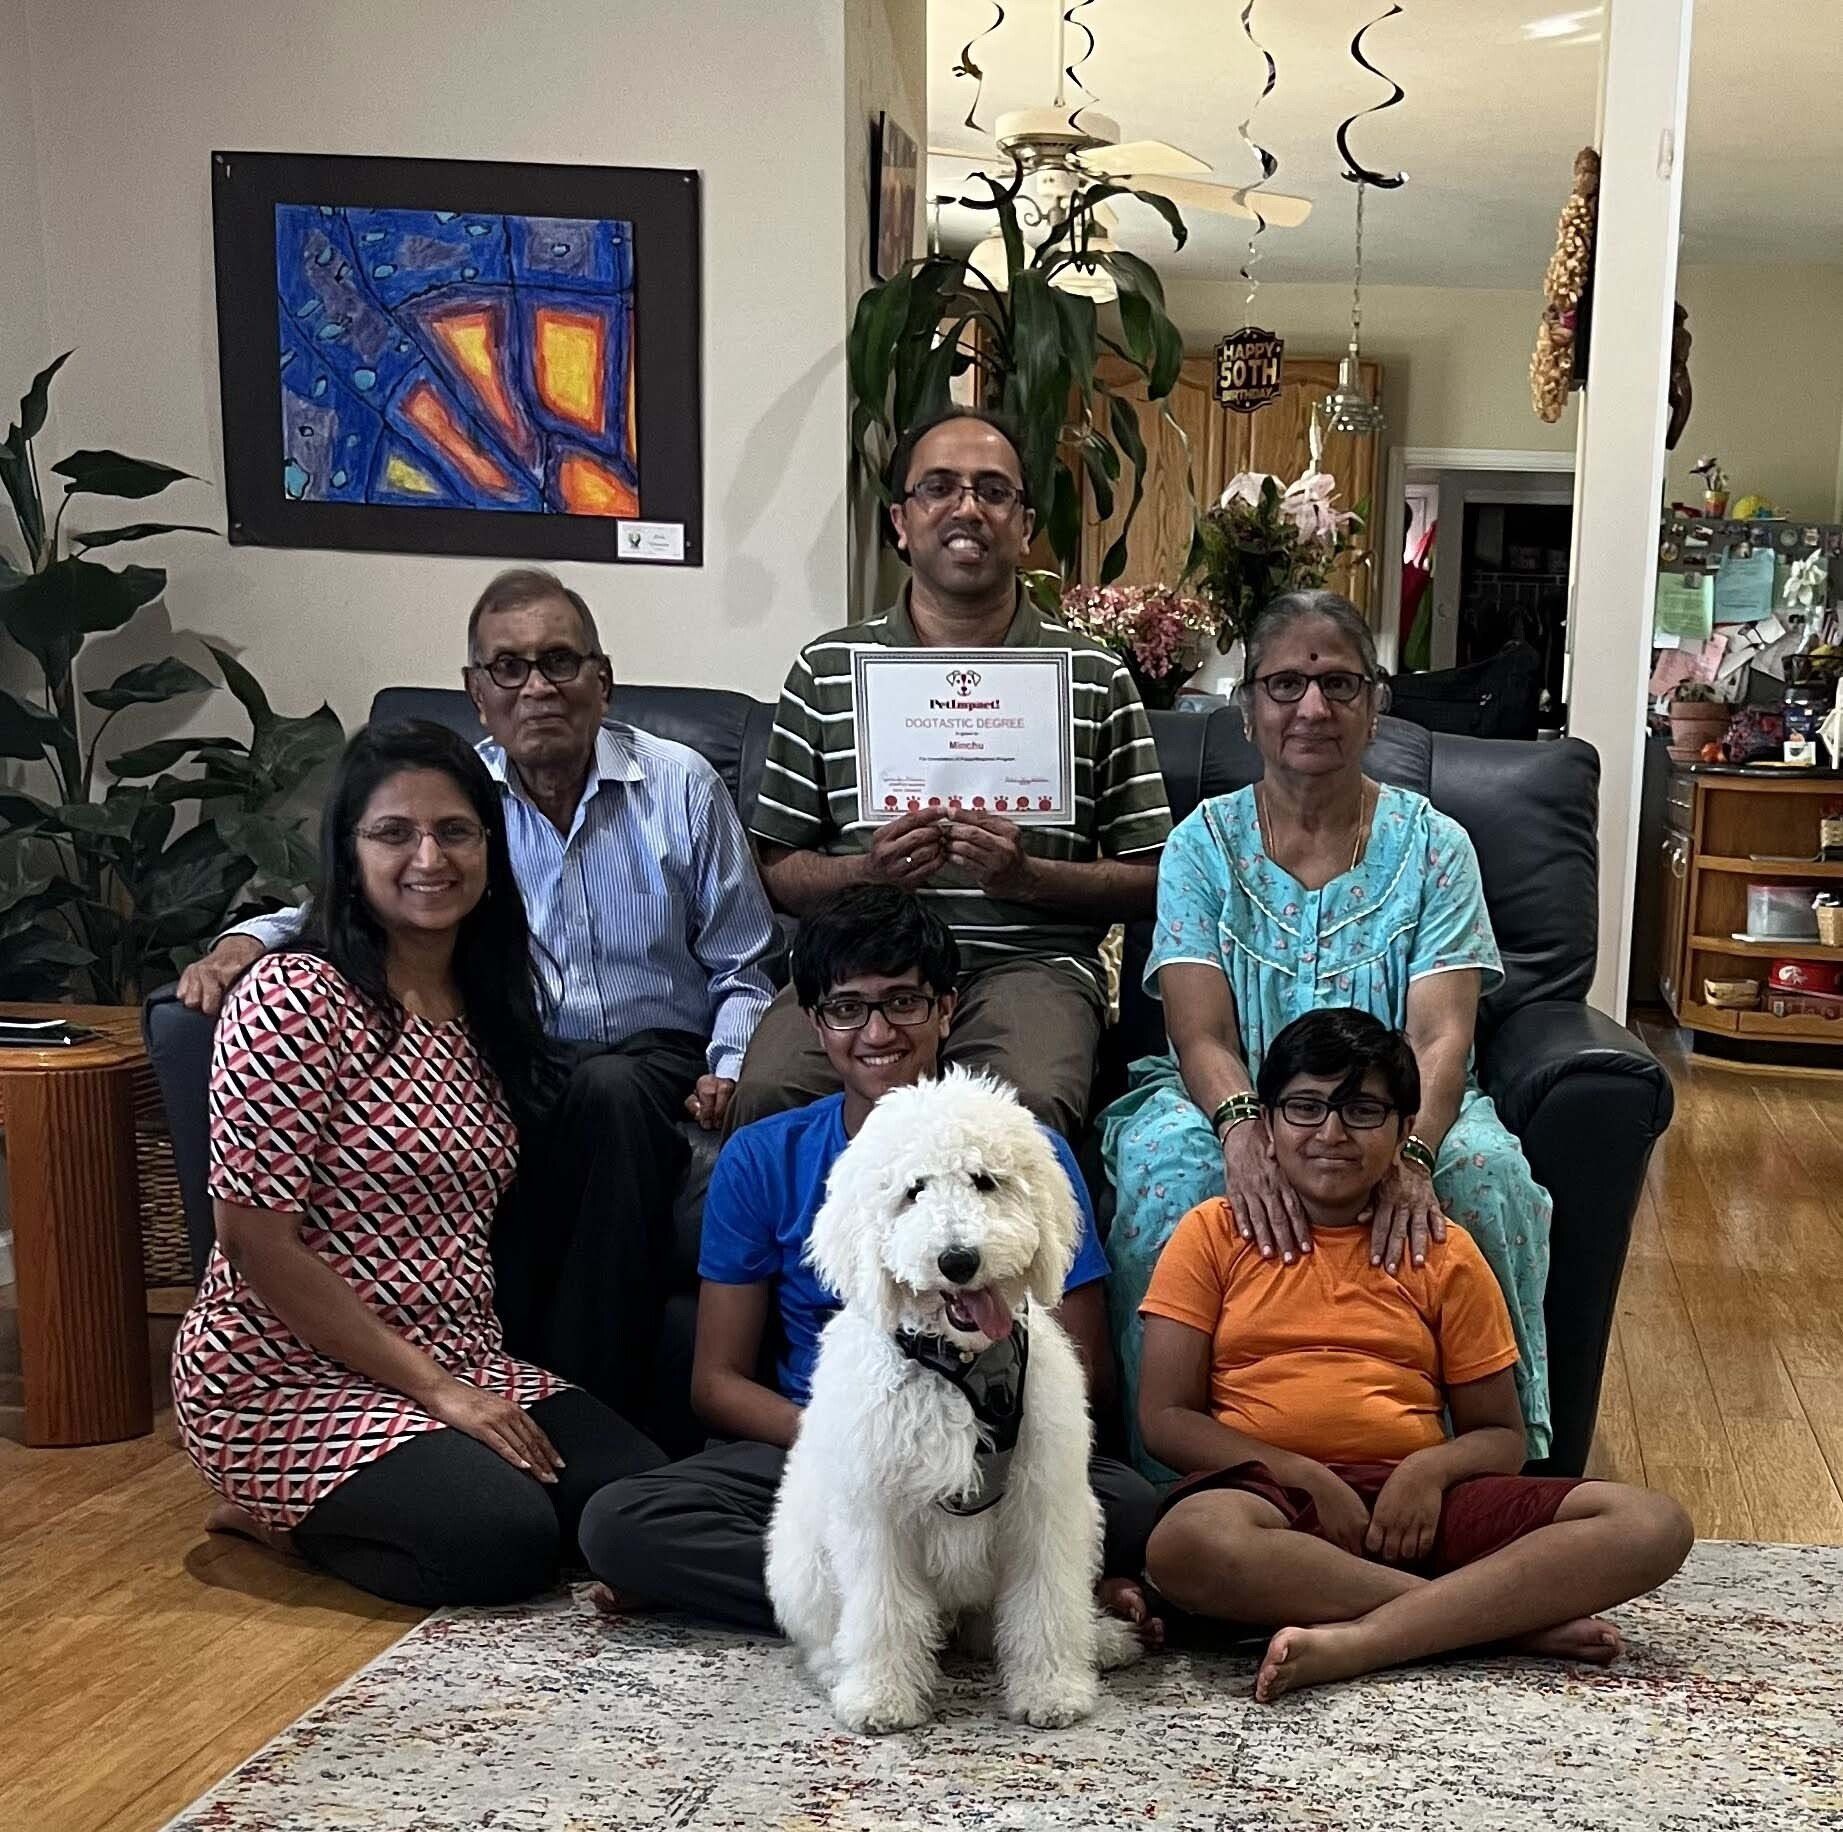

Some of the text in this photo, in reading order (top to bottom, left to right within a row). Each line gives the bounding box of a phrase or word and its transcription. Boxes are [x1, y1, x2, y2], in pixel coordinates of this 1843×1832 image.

[1223, 342, 1275, 361] HAPPY
[1220, 358, 1278, 388] 50TH
[930, 699, 1000, 712] PetImpact!
[905, 717, 1025, 729] DOGTASTIC DEGREE
